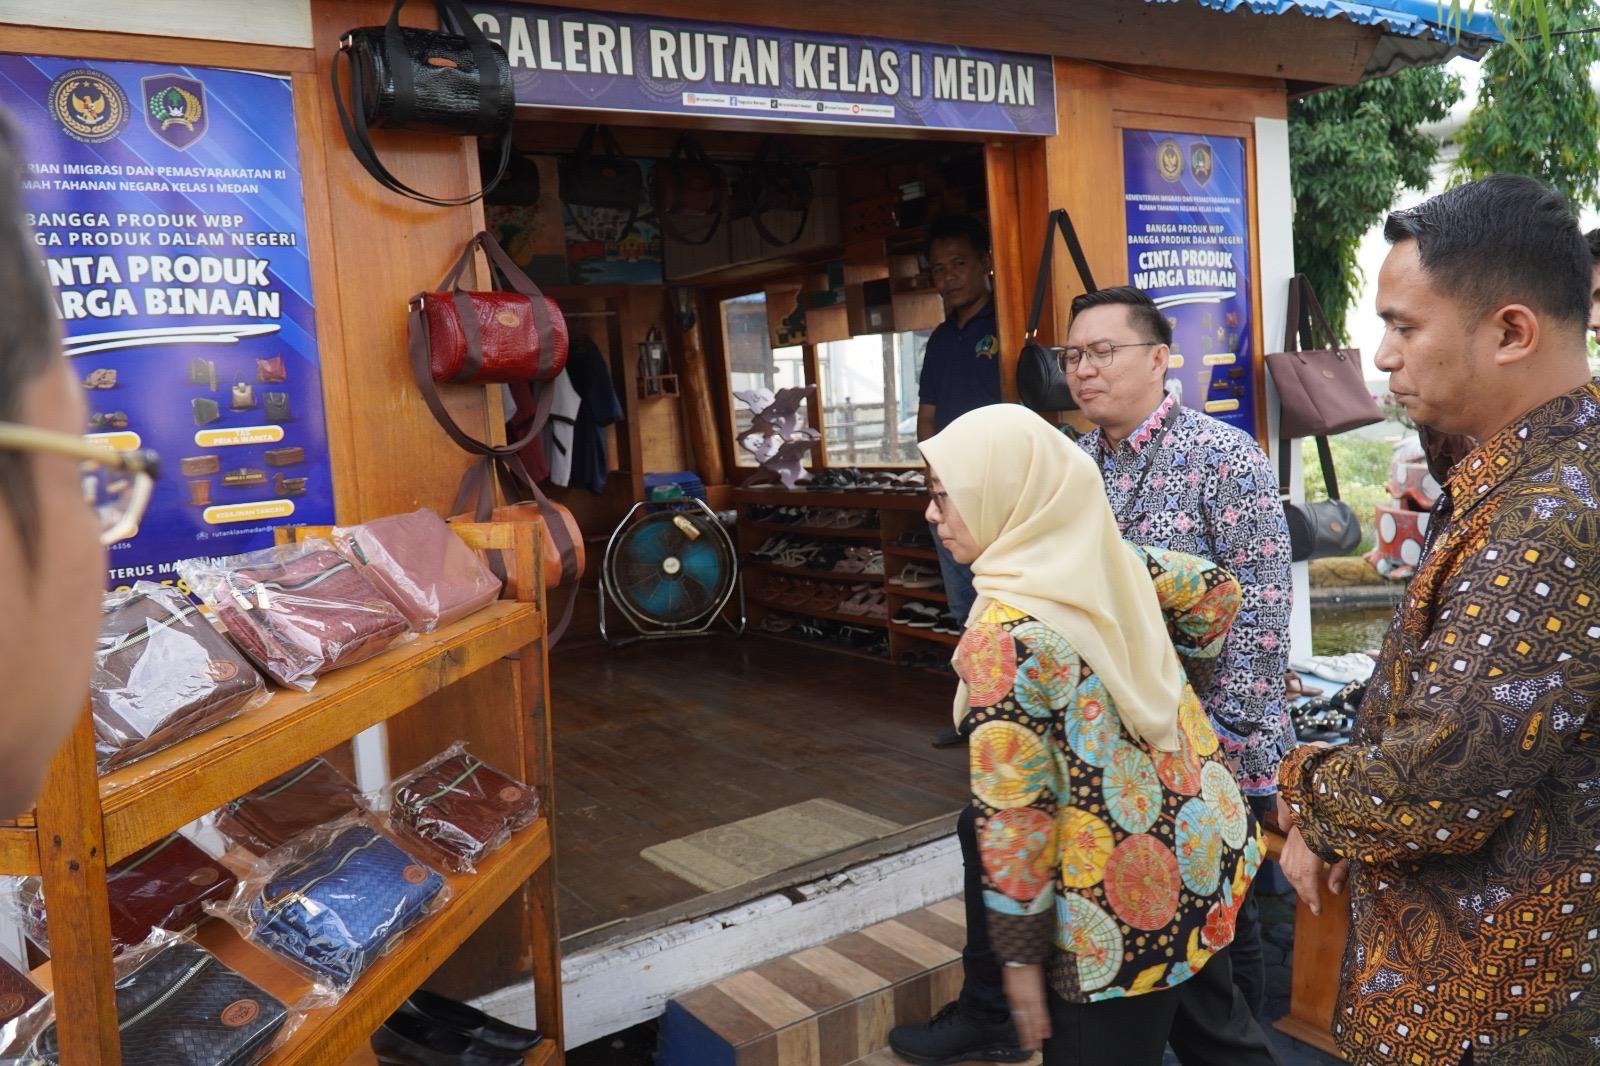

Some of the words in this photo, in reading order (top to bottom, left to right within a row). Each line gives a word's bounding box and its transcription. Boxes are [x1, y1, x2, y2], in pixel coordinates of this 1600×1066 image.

[650, 29, 780, 87] RUTAN
[794, 42, 900, 96] KELAS
[911, 53, 921, 97] I
[933, 56, 1035, 106] MEDAN
[63, 164, 122, 175] IMIGRASI
[126, 165, 154, 176] DAN
[157, 166, 272, 179] PEMASYARAKATAN
[274, 169, 286, 179] RI
[53, 181, 116, 191] TAHANAN
[119, 182, 169, 192] NEGARA
[172, 182, 208, 193] KELAS
[210, 184, 214, 192] I
[216, 184, 259, 193] MEDAN
[25, 213, 111, 227] BANGGA
[117, 213, 198, 227] PRODUK
[203, 214, 244, 228] WBP
[1145, 224, 1176, 233] BANGGA
[1178, 224, 1208, 233] PRODUK
[1209, 225, 1225, 233] WBP
[68, 232, 152, 246] PRODUK
[158, 232, 224, 246] DALAM
[231, 232, 296, 246] NEGERI
[1128, 235, 1160, 244] BANGGA
[1161, 235, 1191, 244] PRODUK
[1193, 235, 1217, 244] DALAM
[1218, 236, 1244, 244] NEGERI
[1138, 250, 1180, 270] CINTA
[1181, 249, 1233, 269] PRODUK
[44, 256, 122, 286] NTA
[128, 255, 270, 286] PRODUK
[1133, 269, 1185, 290] WARGA
[1186, 268, 1237, 288] BINAAN
[144, 287, 280, 318] BINAAN
[109, 564, 154, 580] TERUS
